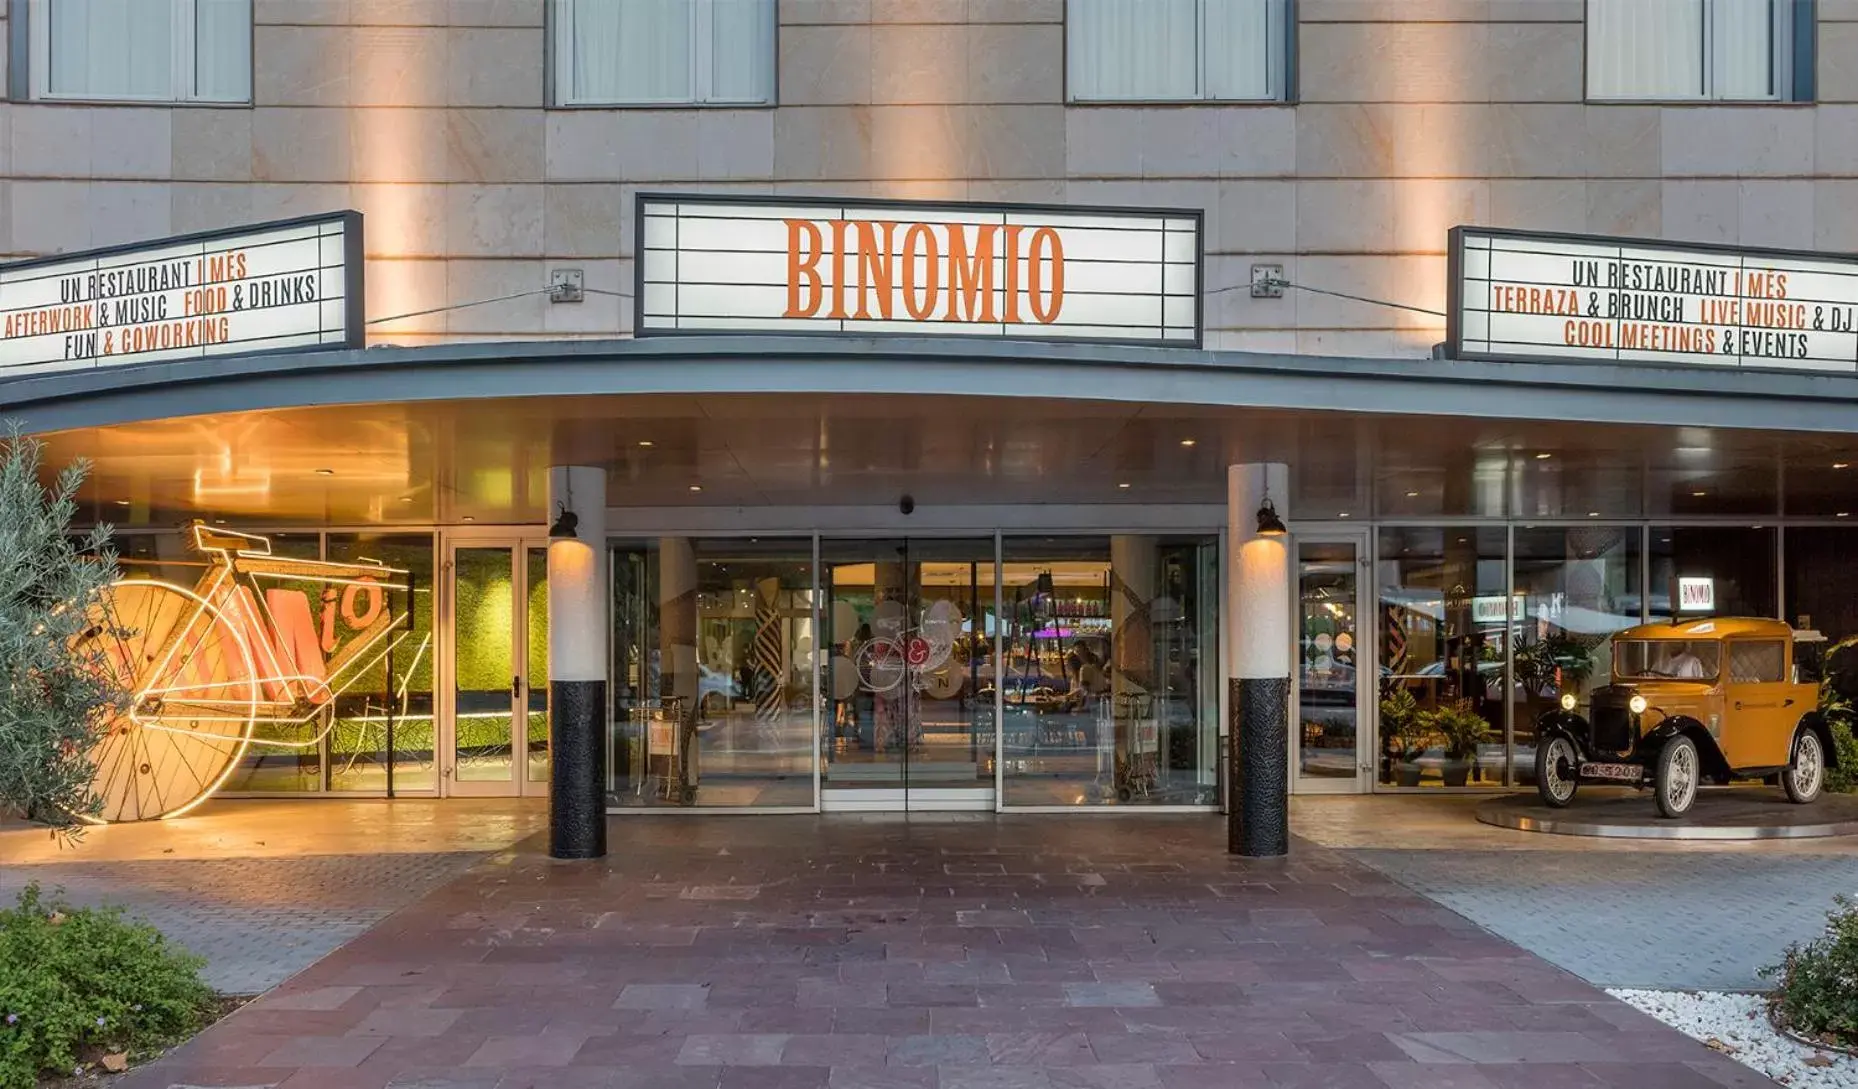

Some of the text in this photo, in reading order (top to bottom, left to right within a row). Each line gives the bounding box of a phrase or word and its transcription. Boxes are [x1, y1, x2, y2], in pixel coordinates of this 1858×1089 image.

[60, 278, 81, 304] UN
[89, 260, 191, 300] RESTAURANT
[782, 219, 1065, 324] BINOMIO
[1572, 260, 1598, 287] UN
[1607, 262, 1728, 296] RESTAURANT
[5, 274, 316, 338] AFTERWORK & MUSIC FOOD & DRINKS
[1494, 285, 1579, 315] TERRAZA
[1587, 292, 1600, 318] &
[1607, 292, 1684, 324] BRUNCH
[1700, 300, 1739, 326] LIVE
[1746, 302, 1806, 330] MUSIC
[1812, 306, 1824, 331] &
[64, 317, 230, 360] FUN & COWORKING
[1564, 320, 1808, 358] COOL MEETINGS & EVENTS
